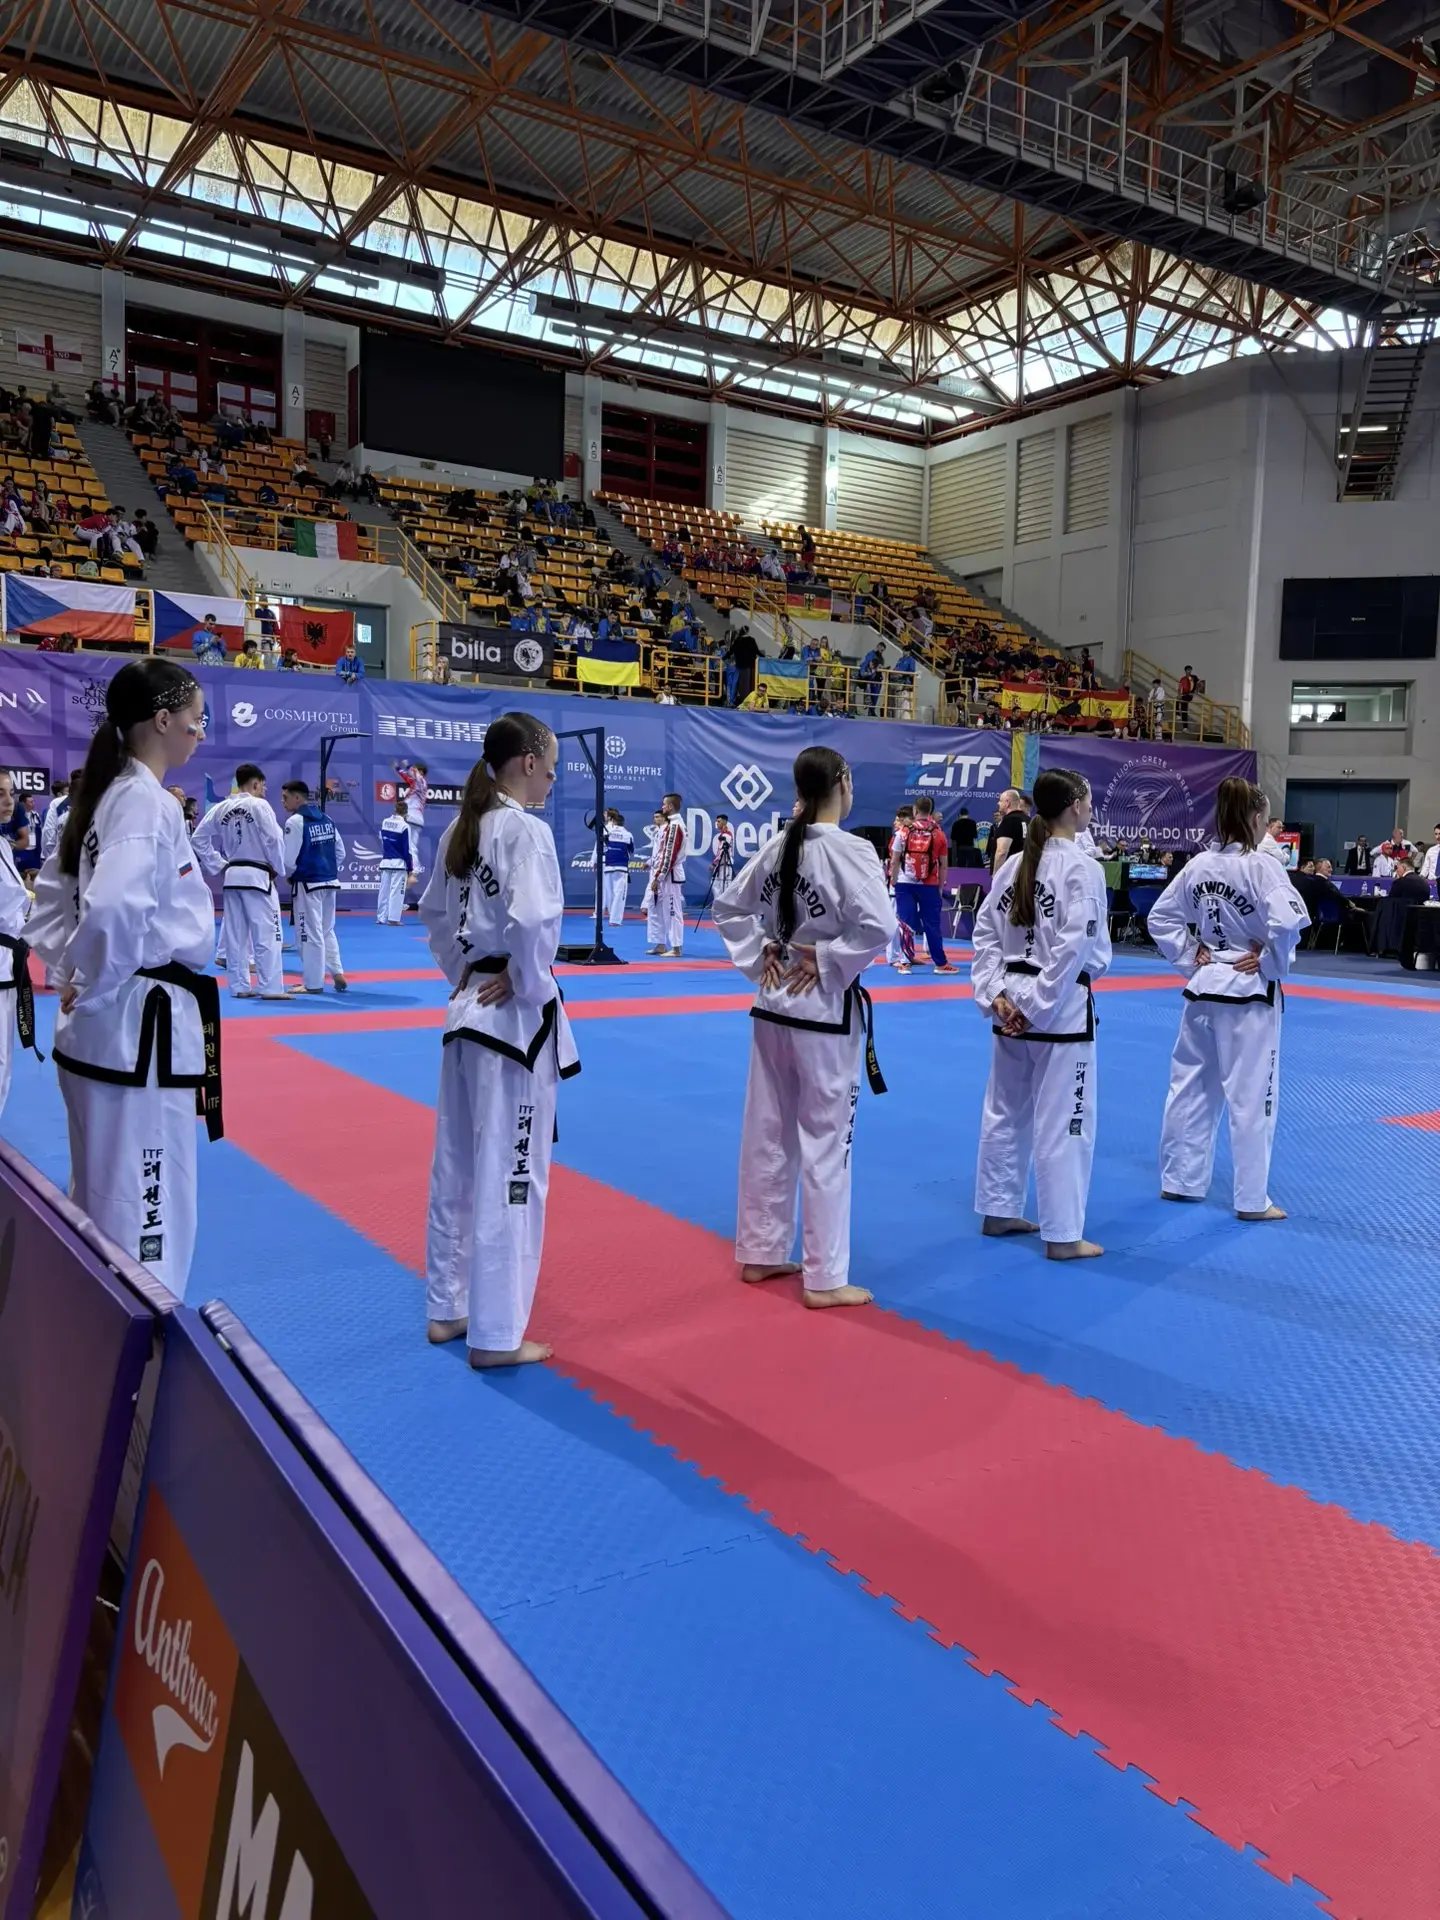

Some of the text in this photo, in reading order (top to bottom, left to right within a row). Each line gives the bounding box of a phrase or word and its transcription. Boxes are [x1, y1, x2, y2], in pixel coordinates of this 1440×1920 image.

[32, 346, 70, 359] ENGLAND
[109, 349, 119, 360] A
[110, 360, 118, 370] 7
[291, 386, 300, 396] A
[292, 396, 299, 406] 7
[590, 441, 598, 451] A
[716, 465, 723, 474] A
[716, 474, 723, 483] 5
[451, 636, 501, 662] billa
[264, 708, 358, 725] COSMHOTEL
[330, 723, 359, 733] Group
[1141, 755, 1168, 769] CRETE
[567, 761, 663, 777] ΠΕΡΙΡΕΙΑ ΚΡΗΤΗΣ
[9, 770, 45, 791] NES
[398, 787, 453, 800] MOAN
[904, 788, 926, 796] EUROPE
[926, 789, 935, 797] ITF
[972, 791, 1000, 799] FEDERATIO
[309, 822, 335, 838] HELLAS
[1092, 825, 1205, 843] TAEKWON-DO ITF
[760, 872, 827, 919] TAEKN-DO
[1076, 1061, 1088, 1070] ITF
[1073, 1069, 1086, 1116] 태권도
[207, 1096, 220, 1111] ITF
[518, 1104, 536, 1115] ITF
[511, 1115, 533, 1177] 태권도
[142, 1148, 165, 1159] ITF
[142, 1160, 164, 1230] 태권도
